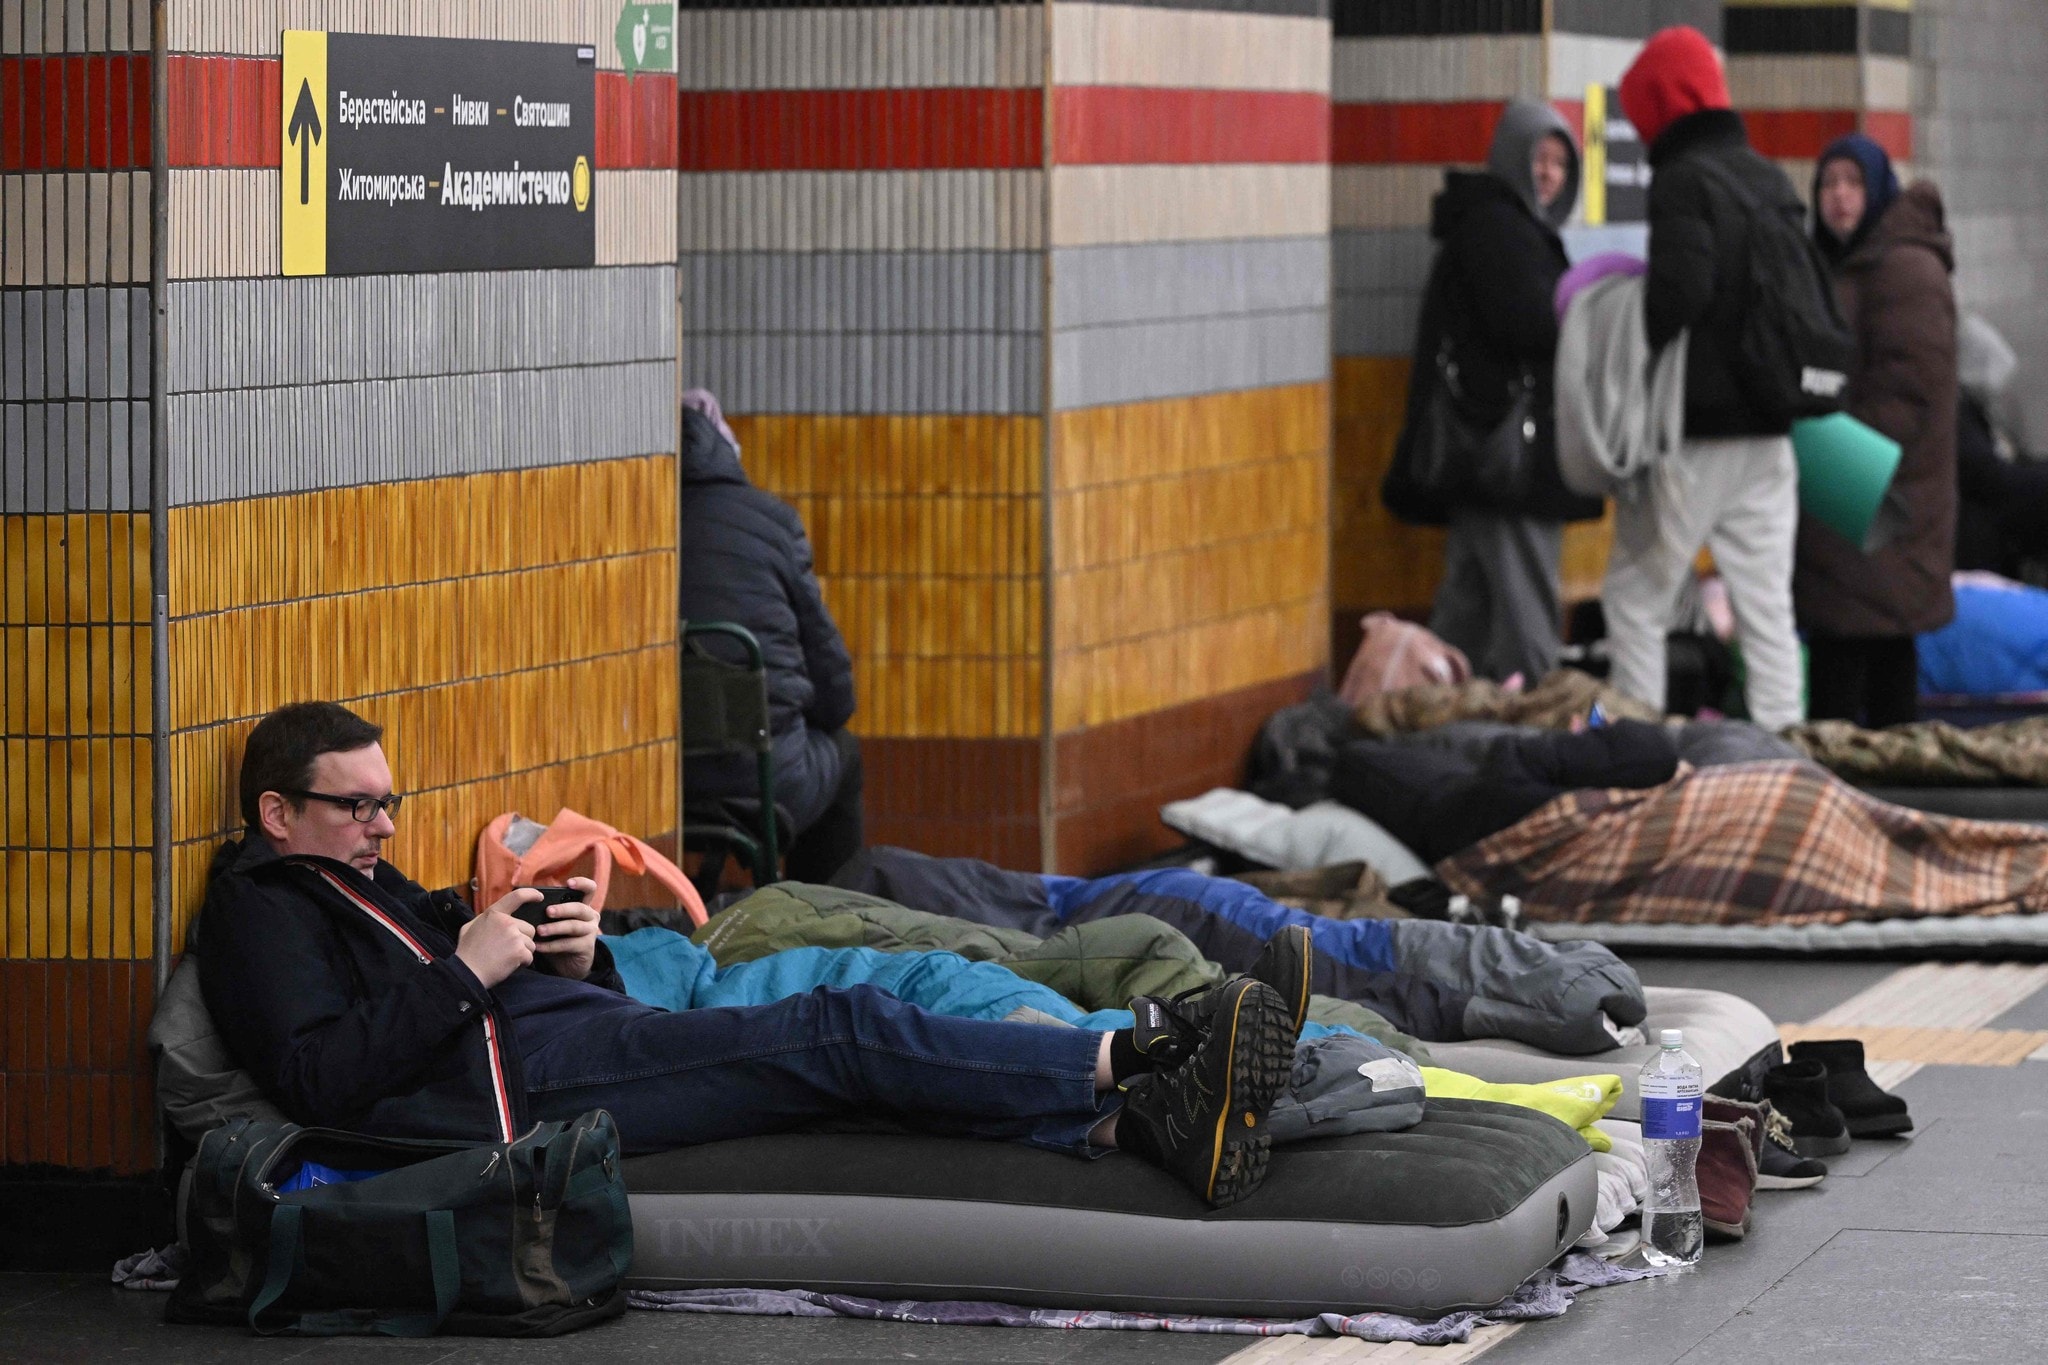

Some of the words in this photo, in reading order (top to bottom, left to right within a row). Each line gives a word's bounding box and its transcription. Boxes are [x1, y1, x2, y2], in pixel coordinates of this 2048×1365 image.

[339, 90, 426, 130] Берестейська
[453, 94, 489, 126] Нивки
[514, 95, 570, 127] Святошин
[338, 168, 425, 207] Житомирська
[441, 160, 570, 211] Академмістечко
[654, 1217, 832, 1256] INTEX
